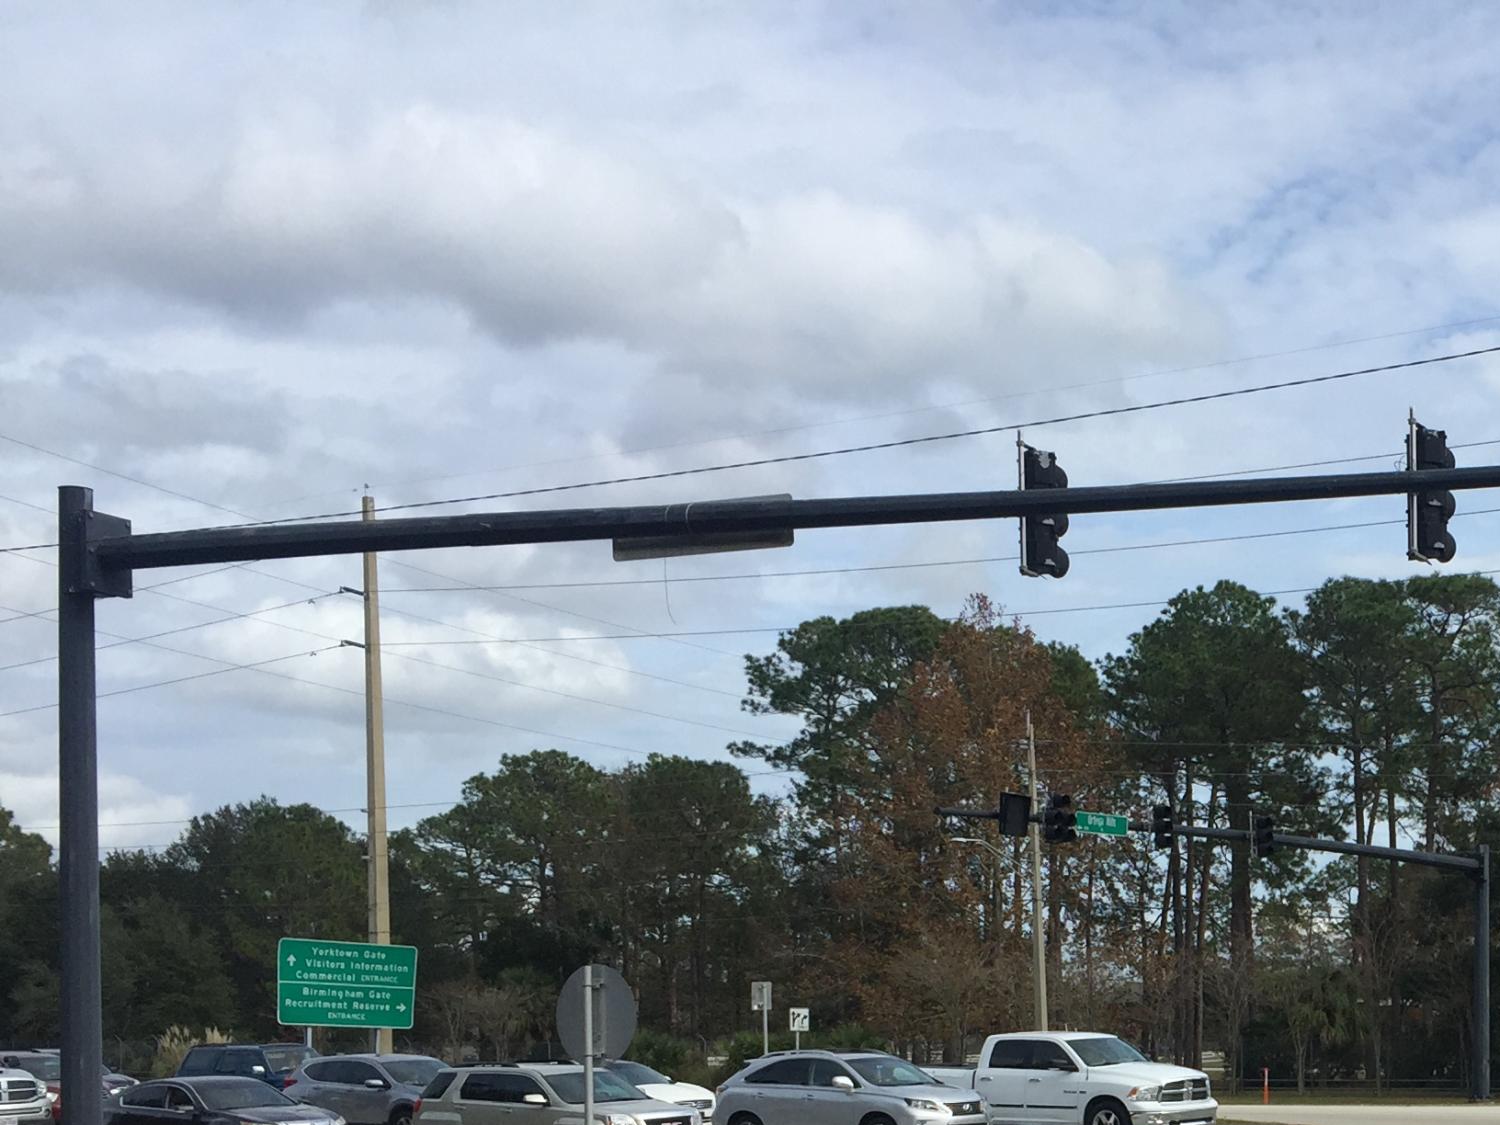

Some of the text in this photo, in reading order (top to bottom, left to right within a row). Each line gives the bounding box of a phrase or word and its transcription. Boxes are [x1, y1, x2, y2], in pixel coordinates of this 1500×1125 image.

[311, 947, 386, 960] Yorktown Gate
[305, 959, 409, 973] Visitors Information
[295, 970, 399, 984] Commercial ENTRANCE
[302, 987, 392, 1000] Birmingham Gate
[285, 998, 391, 1012] Recruitment Reserve
[327, 1012, 366, 1021] ENTRANCE
